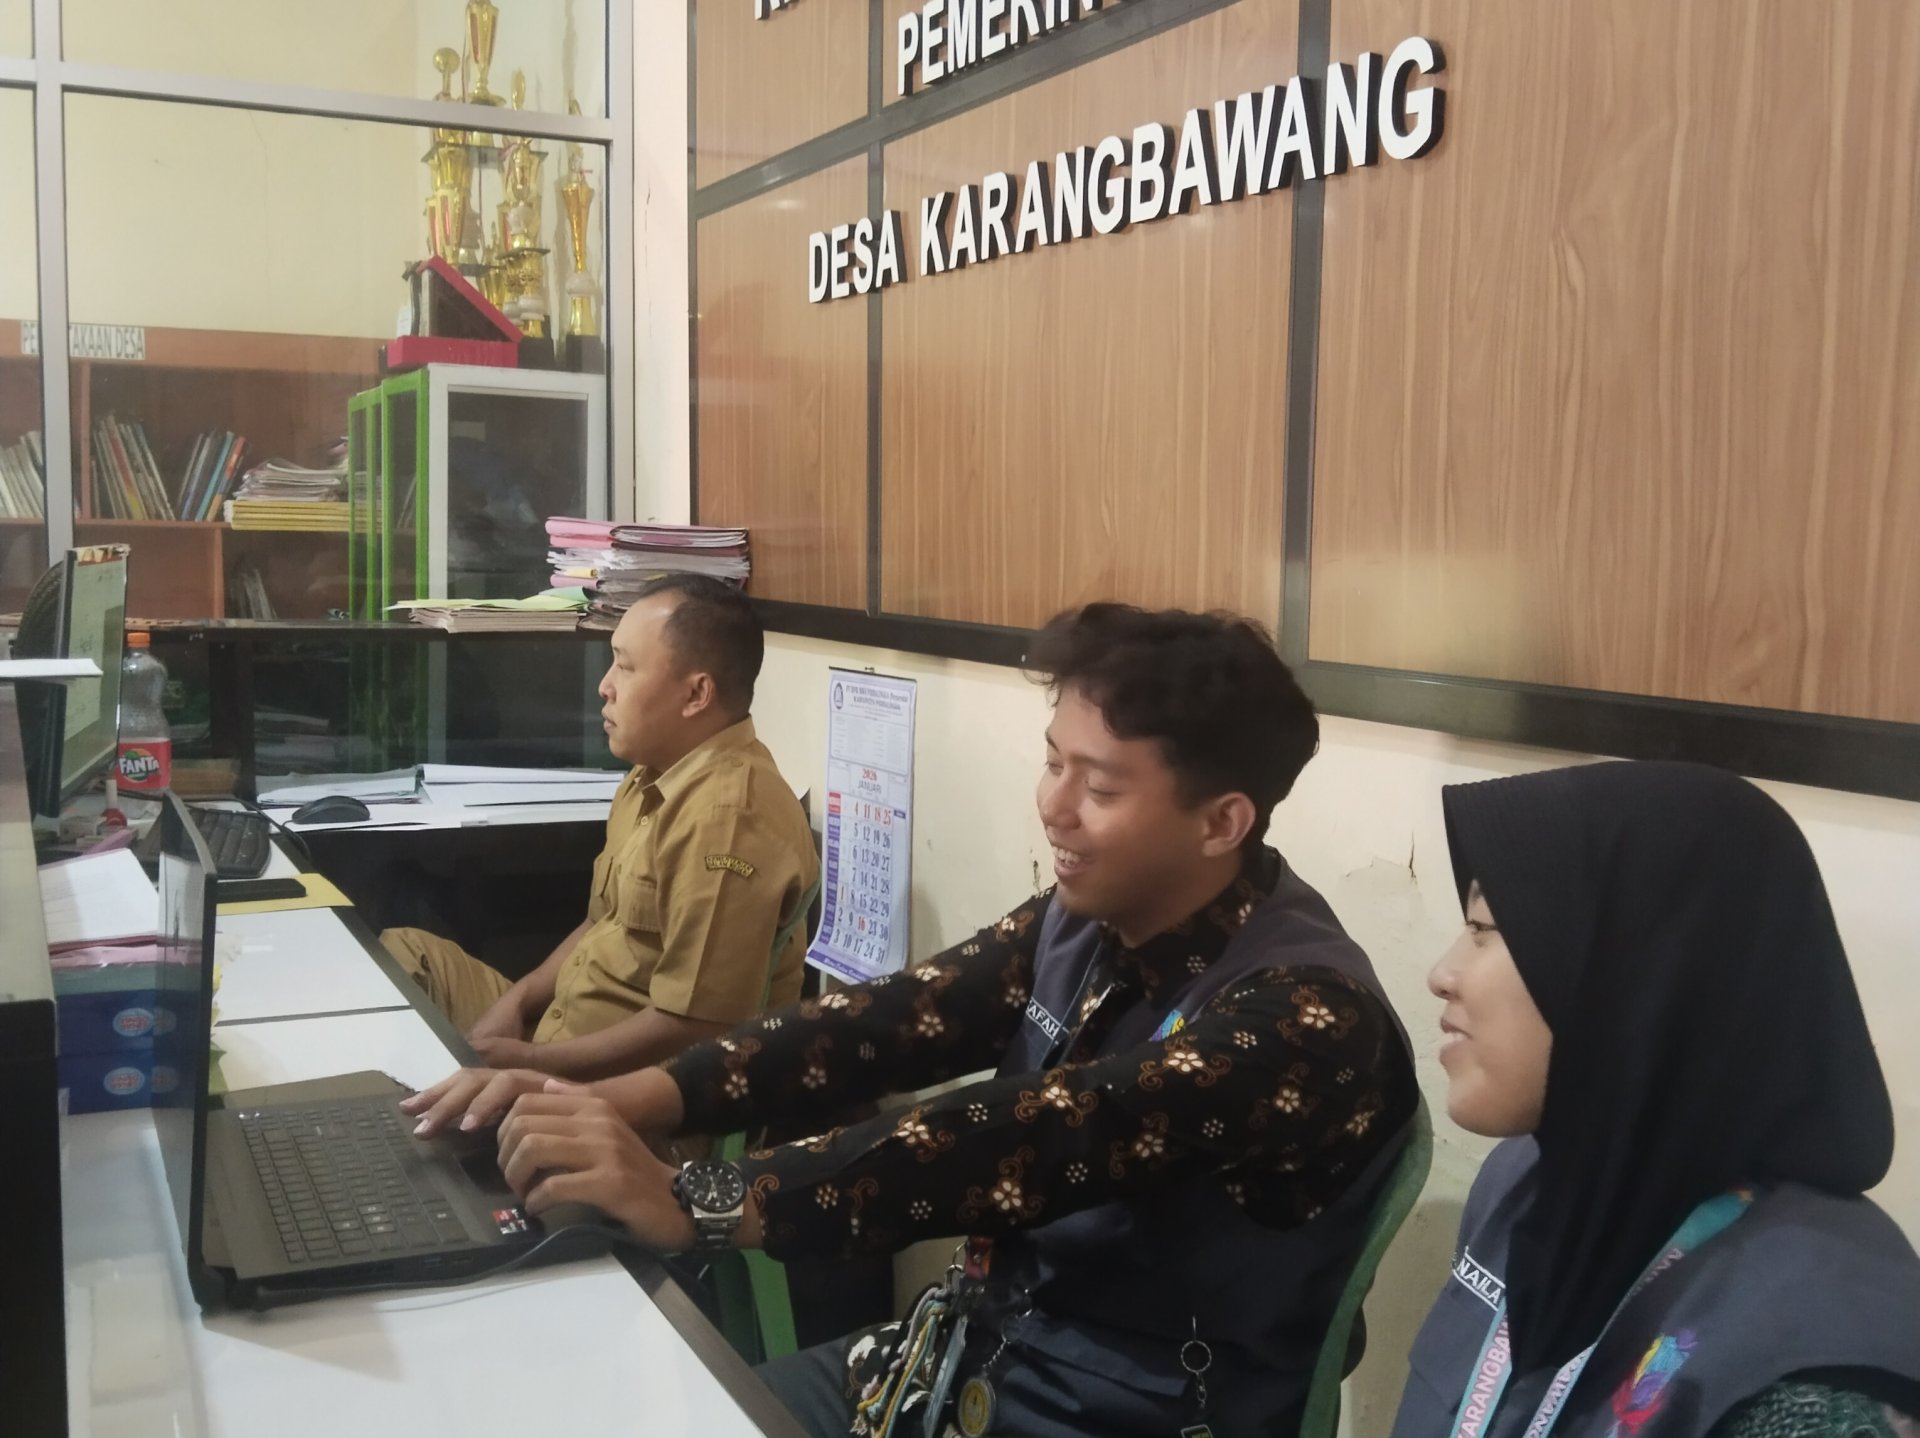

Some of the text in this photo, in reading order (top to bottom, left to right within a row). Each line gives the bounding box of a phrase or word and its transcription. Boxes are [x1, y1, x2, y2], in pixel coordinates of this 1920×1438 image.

[898, 0, 1095, 95] PEME
[809, 36, 1440, 303] DESA KARANGBAWANG
[115, 327, 146, 359] DESA
[119, 756, 160, 774] FANTA
[1457, 1257, 1502, 1304] NAILA
